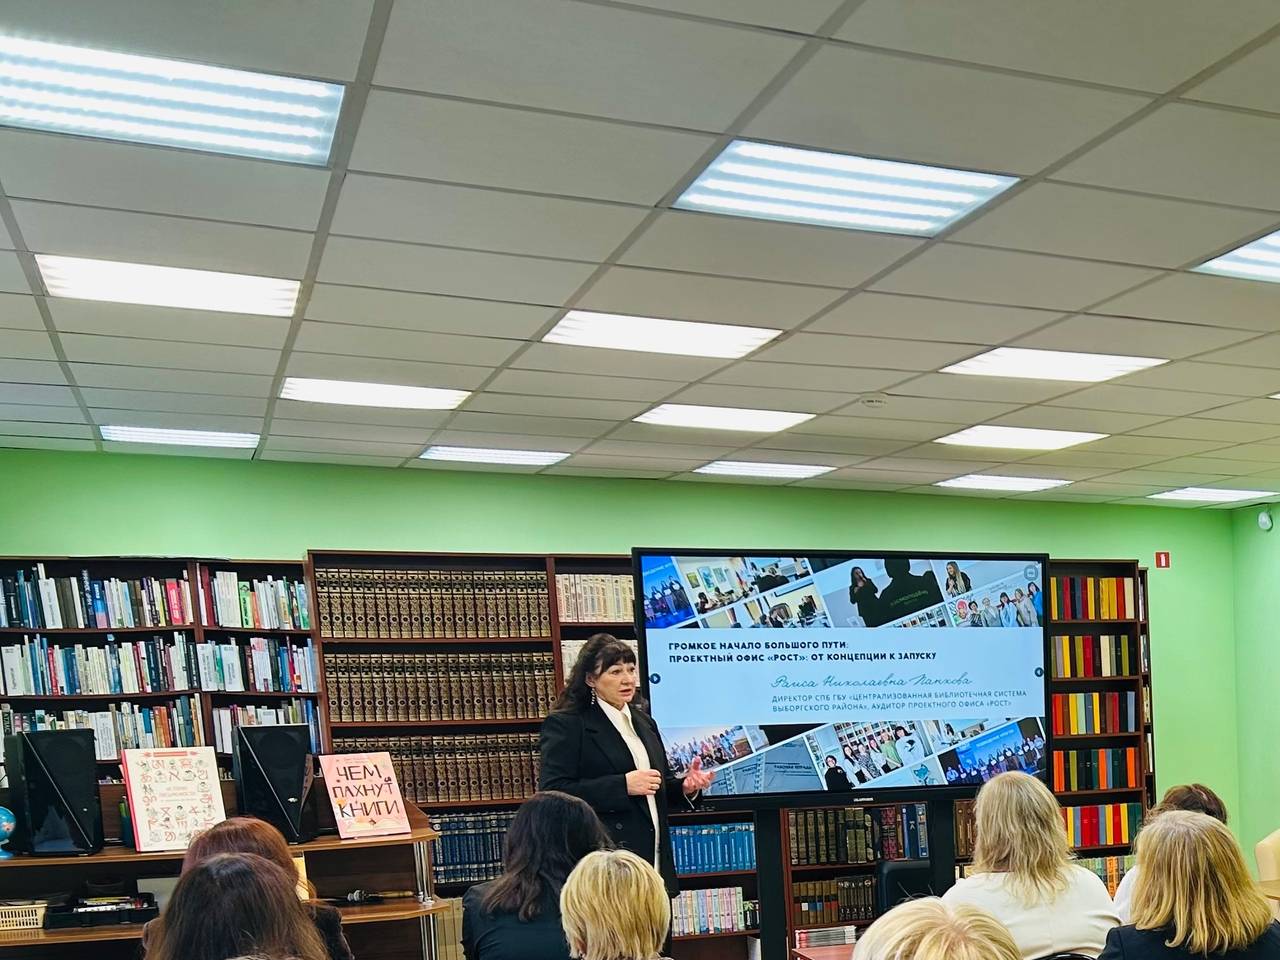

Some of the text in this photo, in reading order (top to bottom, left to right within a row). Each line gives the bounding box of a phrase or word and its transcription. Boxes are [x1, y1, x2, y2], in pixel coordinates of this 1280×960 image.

[669, 641, 849, 650] ГРОМКОЕ НАЧАЛО БОЛЬШОГО ПУТИ:
[669, 653, 734, 663] ПРОЕКТНЫЙ
[736, 654, 765, 662] ОФИС
[811, 653, 824, 661] ОТ
[827, 652, 887, 662] КОНЦЕПЦИИ
[889, 652, 896, 660] К
[898, 652, 936, 660] ЗАПУСКУ
[772, 694, 813, 703] ДИРЕКТОР
[832, 693, 847, 701] ГБУ
[934, 691, 992, 699] БИБЛИОТЕЧНАЯ
[772, 704, 830, 712] ВЫБОРГСКОГО
[872, 702, 906, 711] АУДИТОР
[908, 701, 957, 709] ПРОЕКТНОГО
[959, 700, 985, 708] ОФИСА
[336, 764, 382, 780] ЧЕМ
[332, 782, 393, 798] ПАХНУТ
[338, 800, 400, 818] КНИГИ
